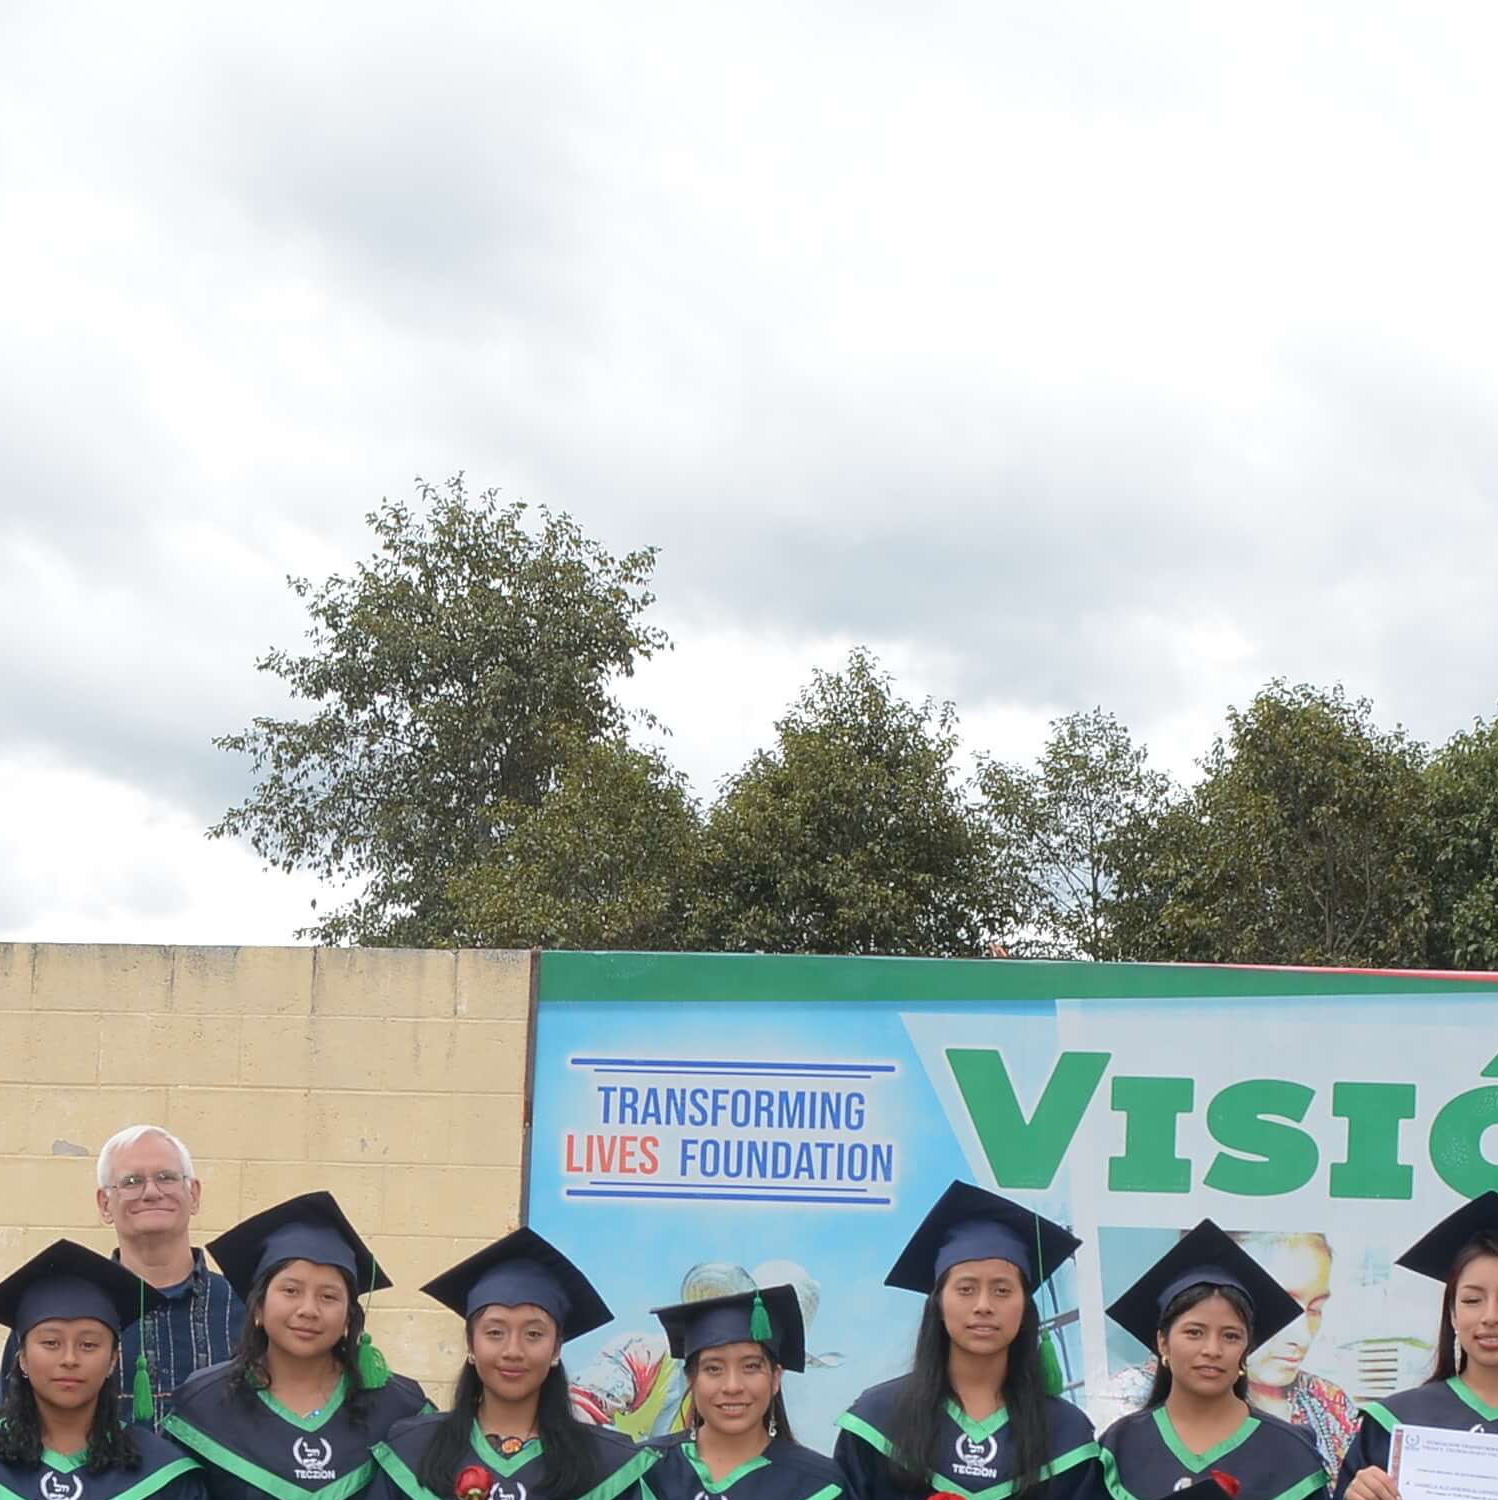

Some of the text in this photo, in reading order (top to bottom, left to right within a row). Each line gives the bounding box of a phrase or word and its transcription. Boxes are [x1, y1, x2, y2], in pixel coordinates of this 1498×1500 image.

[597, 1085, 866, 1131] TRANSFORMING
[565, 1134, 894, 1182] LIVES FOUNDATION
[294, 1469, 336, 1480] TECZION
[952, 1463, 998, 1479] TECZION
